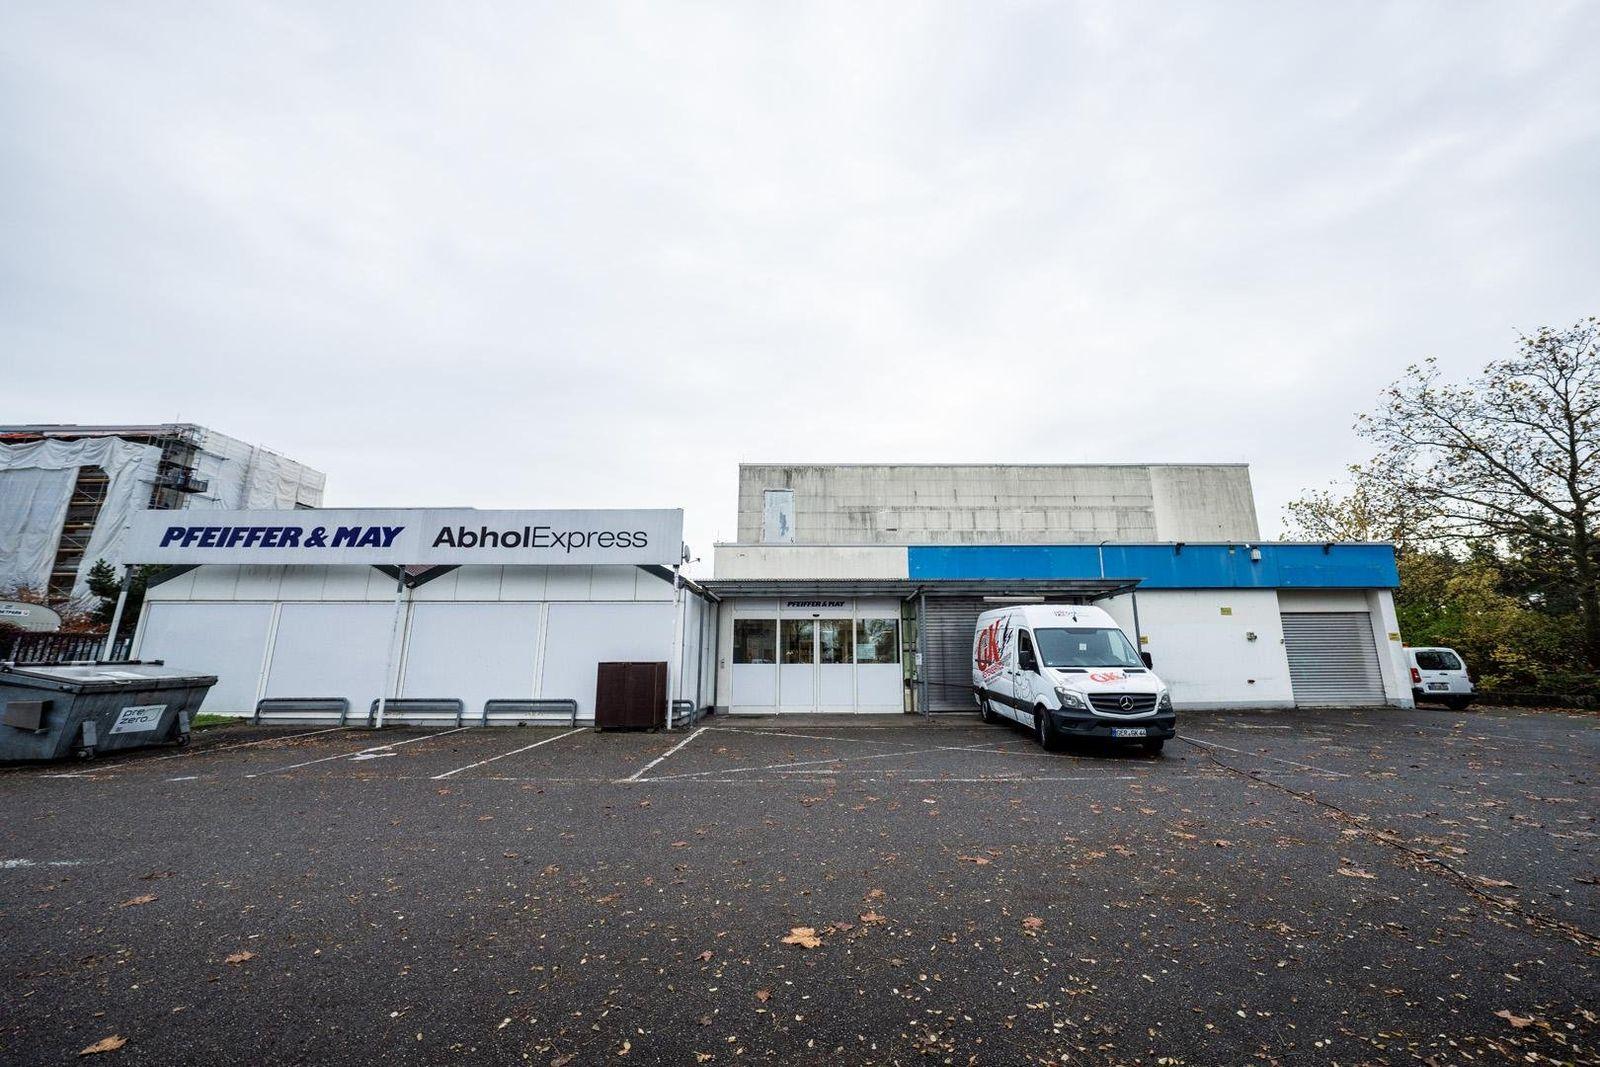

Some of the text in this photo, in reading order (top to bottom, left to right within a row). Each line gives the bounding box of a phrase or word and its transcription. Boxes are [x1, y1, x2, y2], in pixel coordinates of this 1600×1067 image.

[159, 526, 406, 548] PFEIFFER & MAY
[432, 526, 649, 553] AbholExpress
[119, 715, 149, 725] zero
[122, 708, 146, 718] pre
